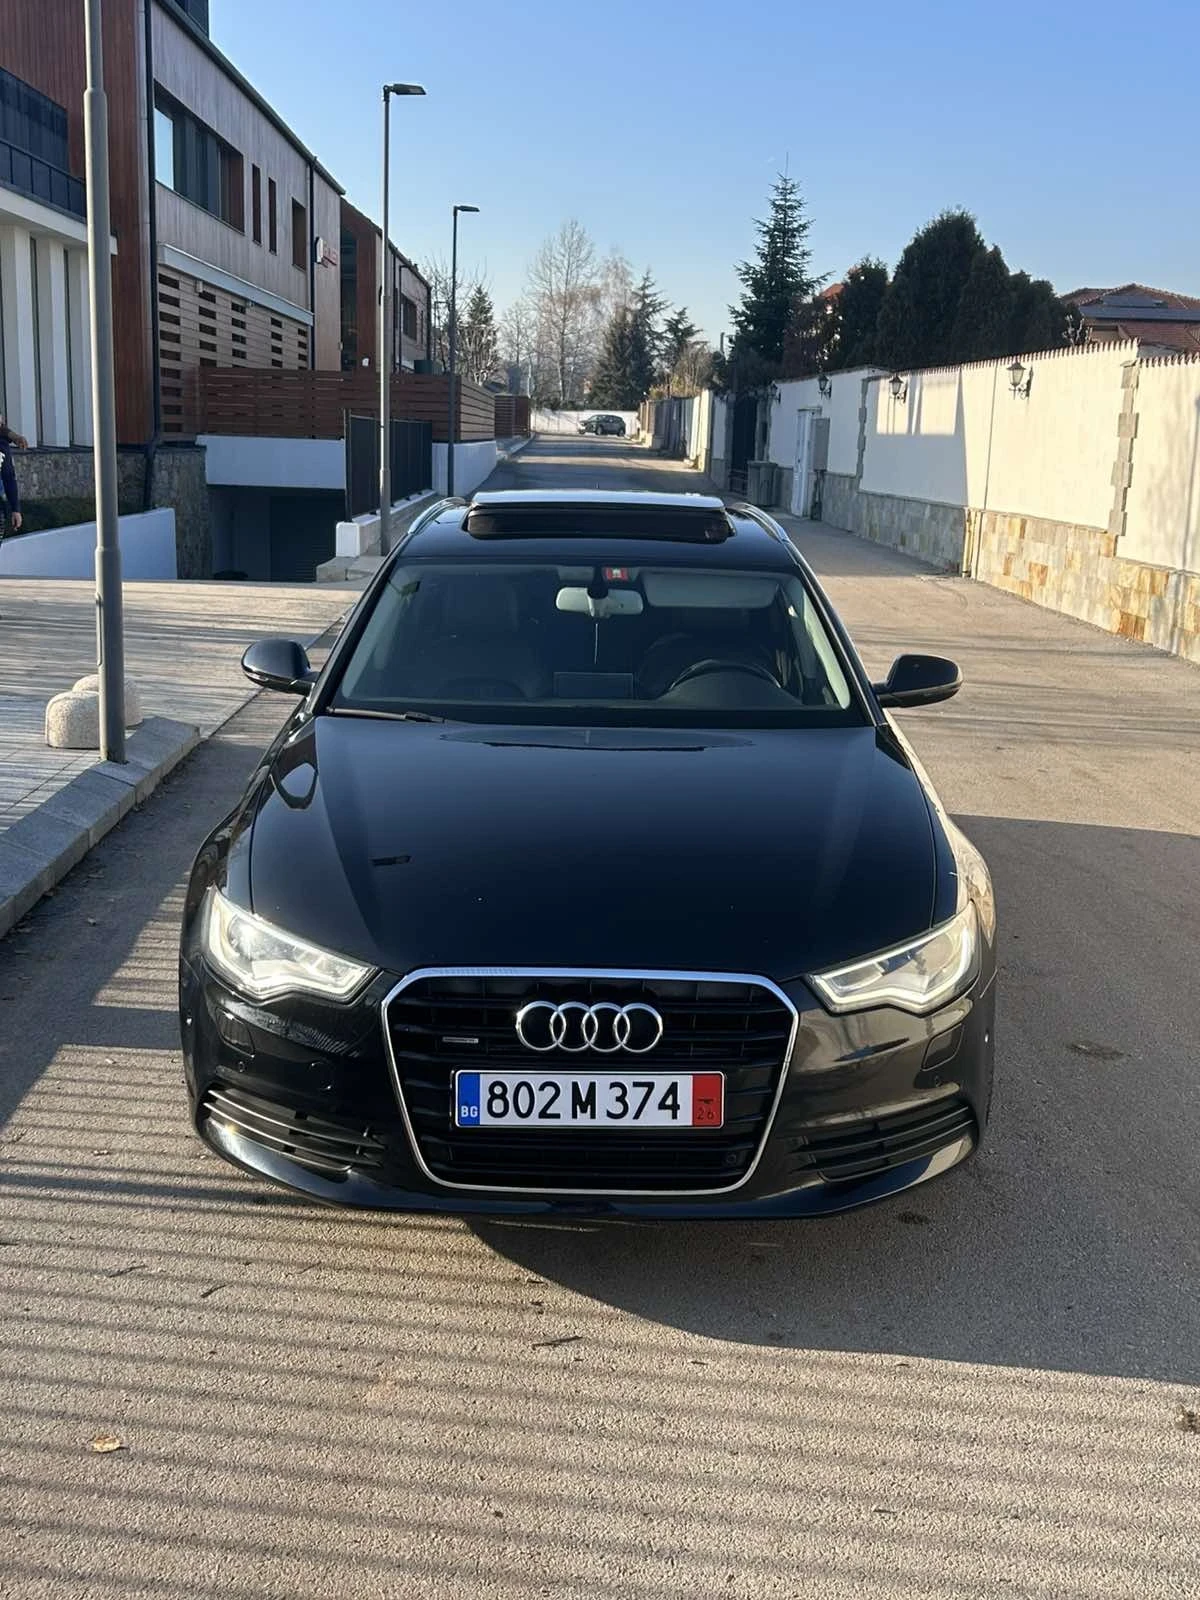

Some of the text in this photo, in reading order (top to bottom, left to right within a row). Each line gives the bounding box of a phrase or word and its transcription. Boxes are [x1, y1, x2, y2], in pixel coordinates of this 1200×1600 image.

[460, 1105, 479, 1119] BG
[486, 1080, 681, 1120] 802 M 374
